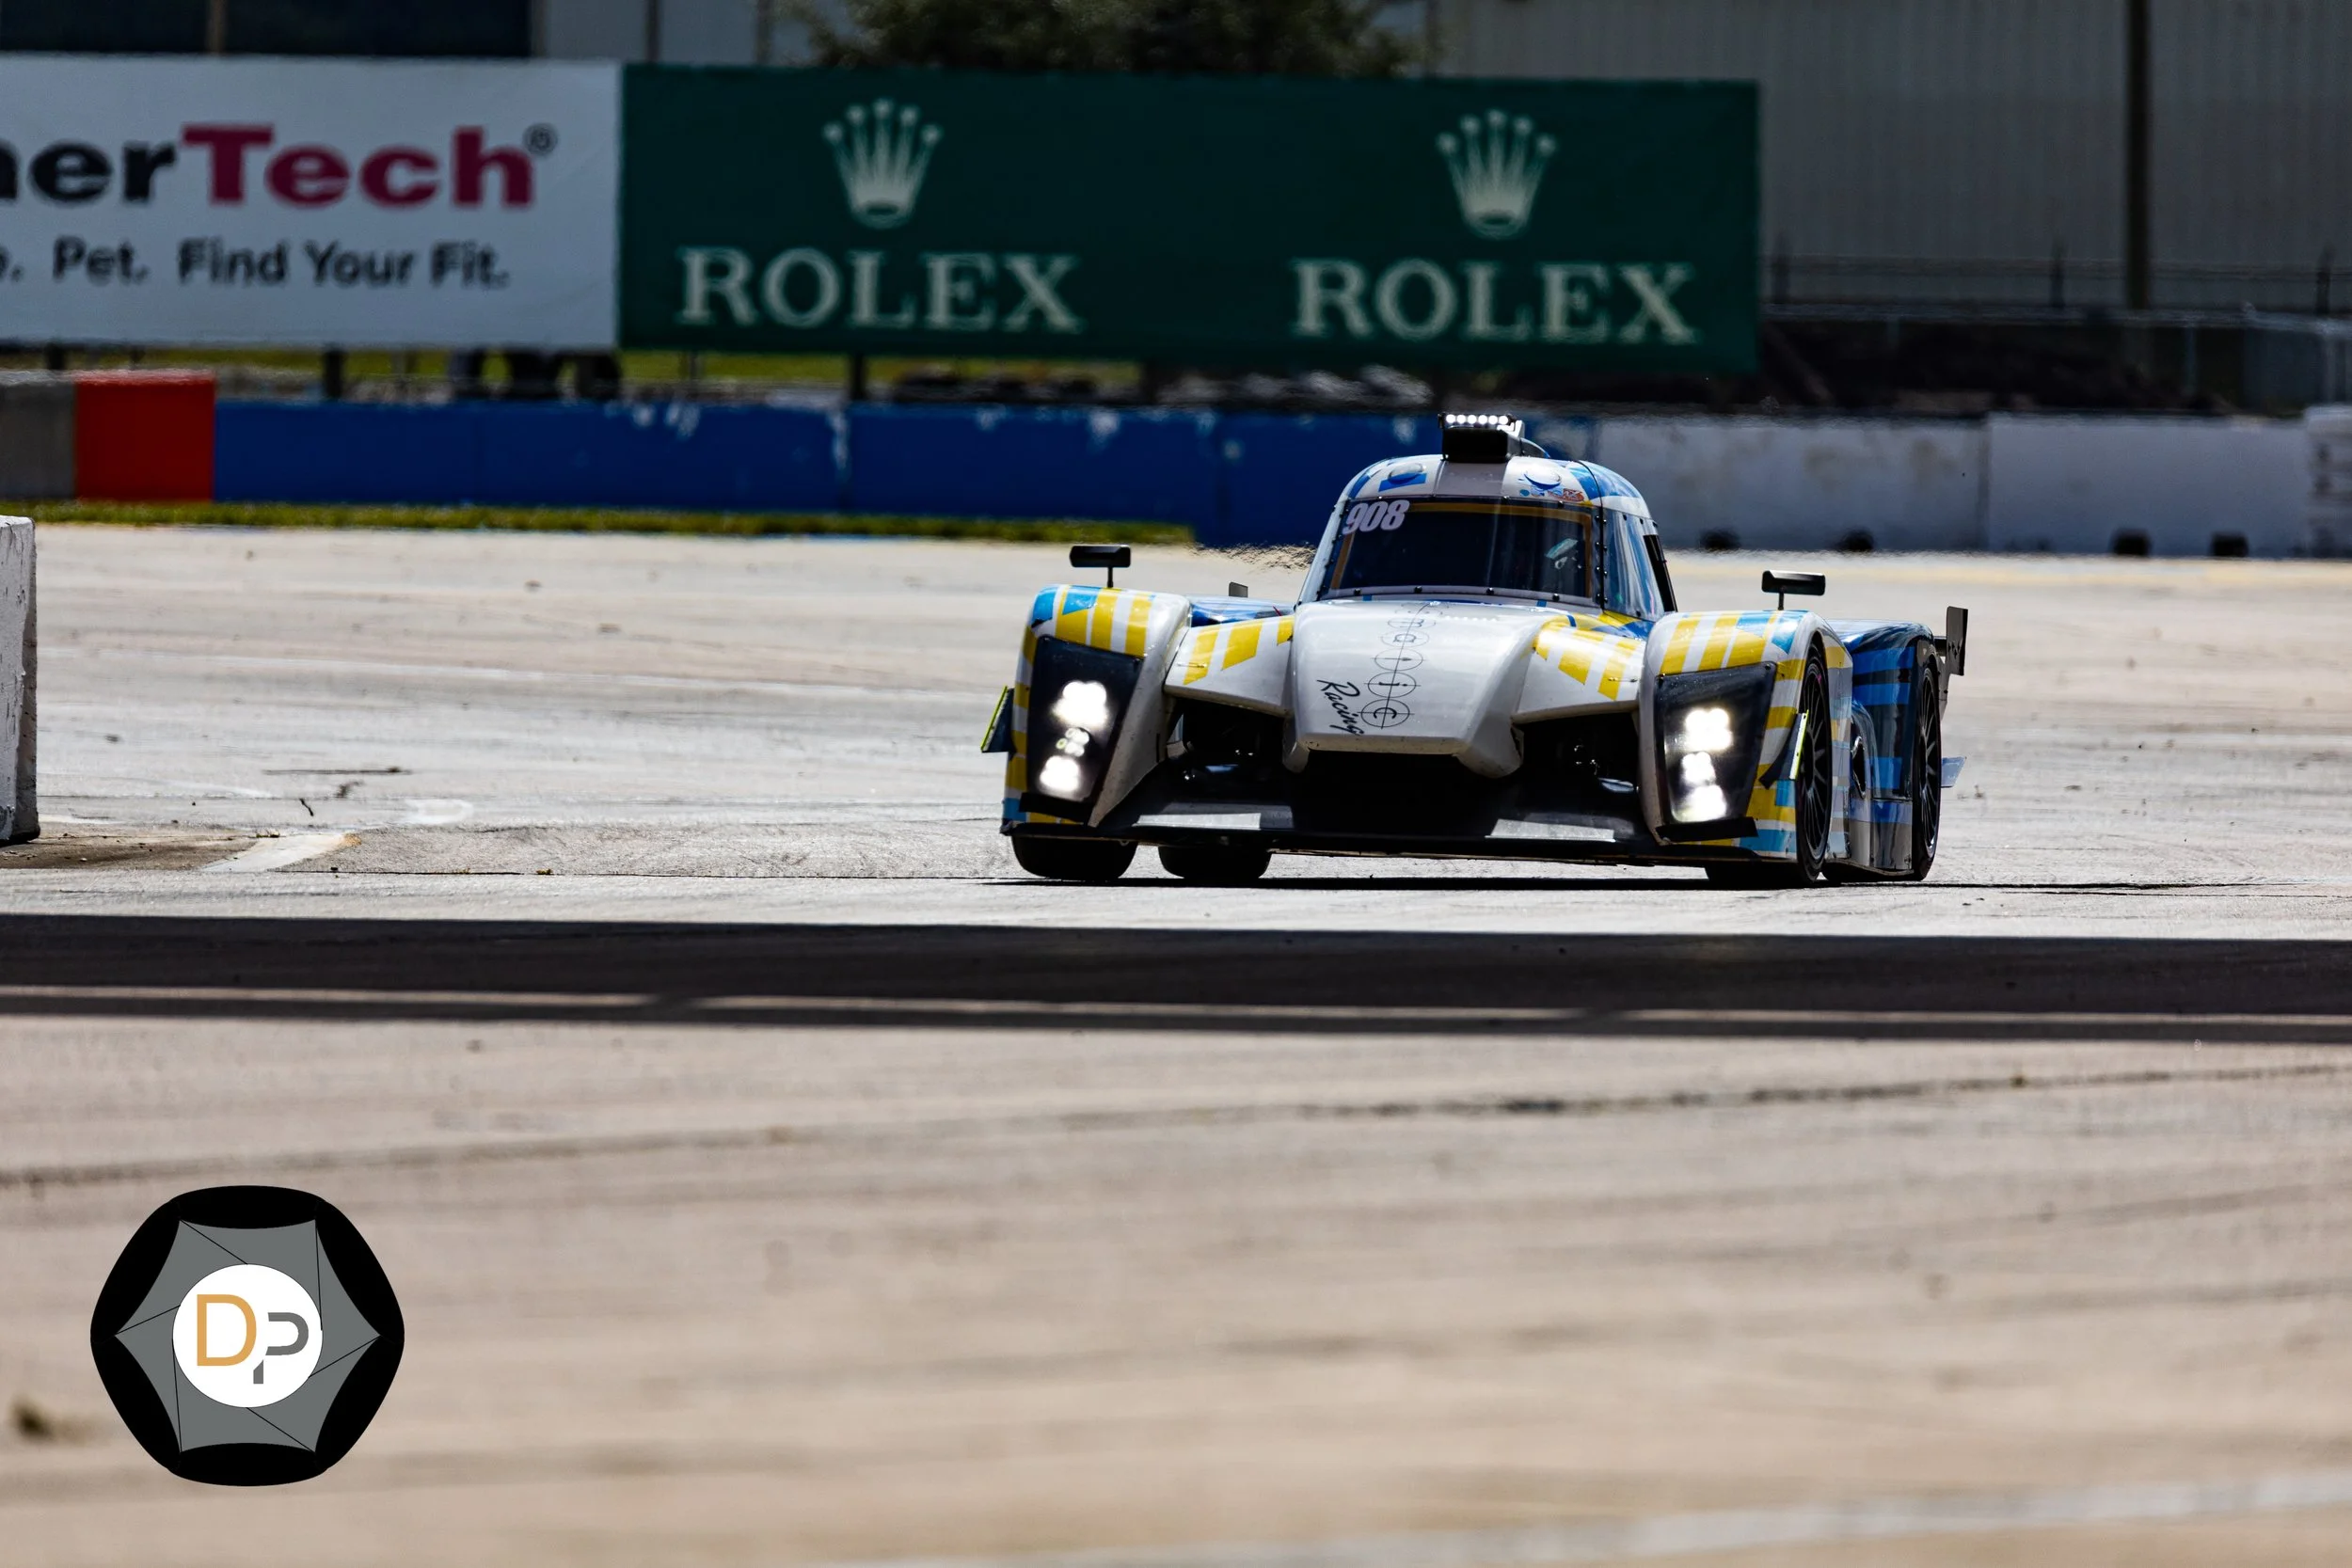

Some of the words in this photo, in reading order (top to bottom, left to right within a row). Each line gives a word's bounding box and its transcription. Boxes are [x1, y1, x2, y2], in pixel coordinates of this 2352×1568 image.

[52, 235, 149, 284] Pet.
[178, 239, 289, 284] Find
[304, 241, 416, 286] Your
[430, 241, 509, 288] Fit.
[679, 246, 1079, 332] ROLEX
[1294, 258, 1696, 344] ROLEX
[1342, 499, 1410, 535] 908
[1316, 678, 1365, 736] Racing
